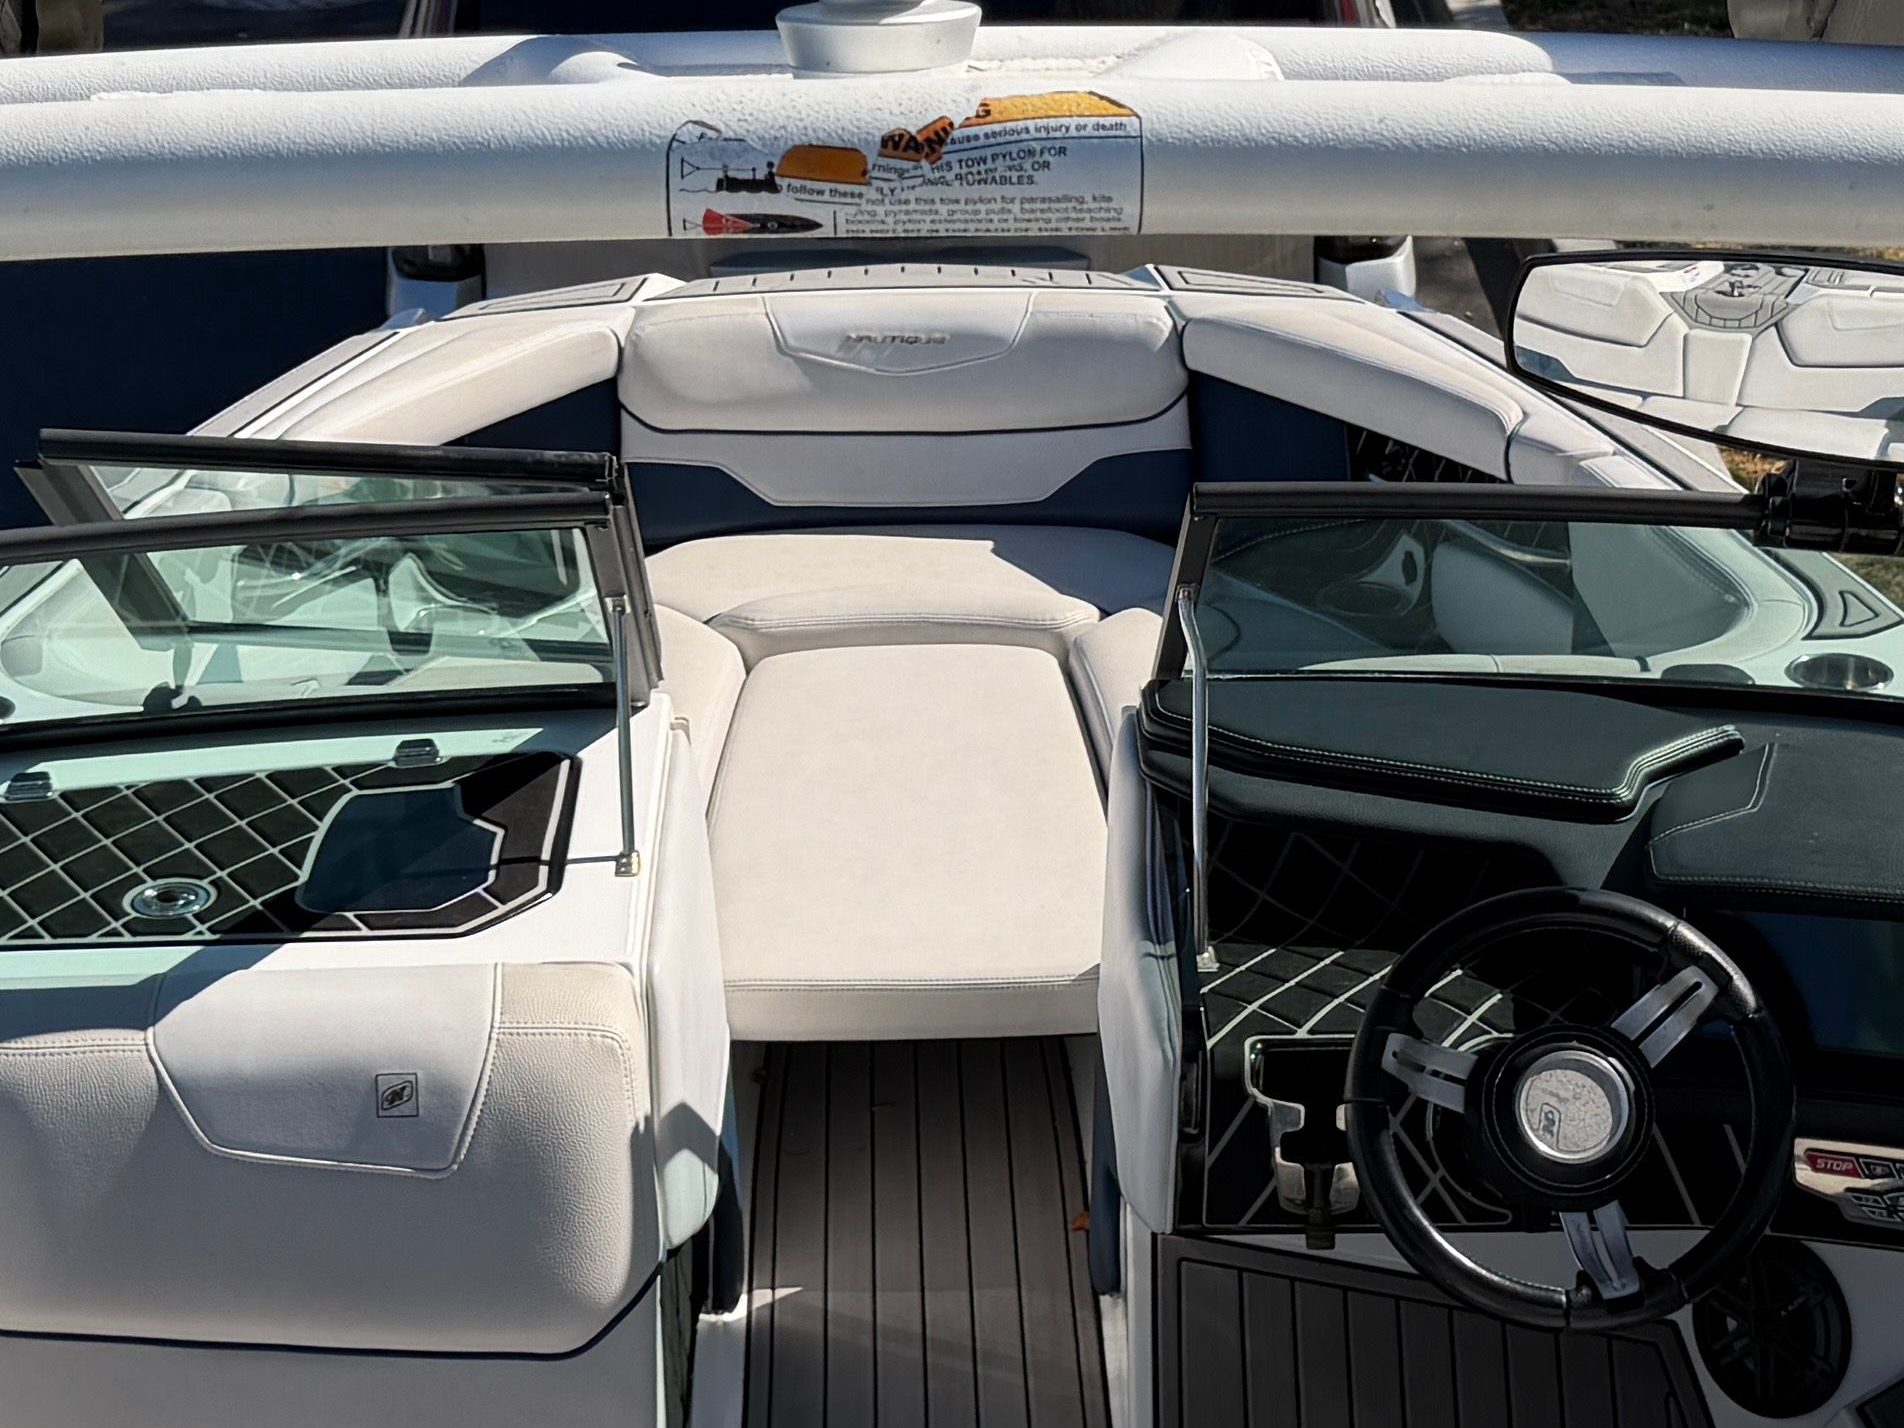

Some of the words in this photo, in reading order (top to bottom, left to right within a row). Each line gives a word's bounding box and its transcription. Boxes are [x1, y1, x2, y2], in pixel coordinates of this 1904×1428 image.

[949, 132, 981, 146] ause
[982, 127, 1030, 140] serious
[1034, 122, 1072, 136] injury
[1074, 122, 1088, 132] or
[1092, 120, 1127, 132] death
[957, 157, 988, 170] TOW
[991, 148, 1036, 166] PYLON
[1039, 146, 1067, 158] FOR
[1031, 160, 1051, 172] OR
[786, 184, 826, 197] follow
[829, 186, 864, 200] these
[914, 197, 936, 205] this
[1815, 1157, 1854, 1171] STOP
